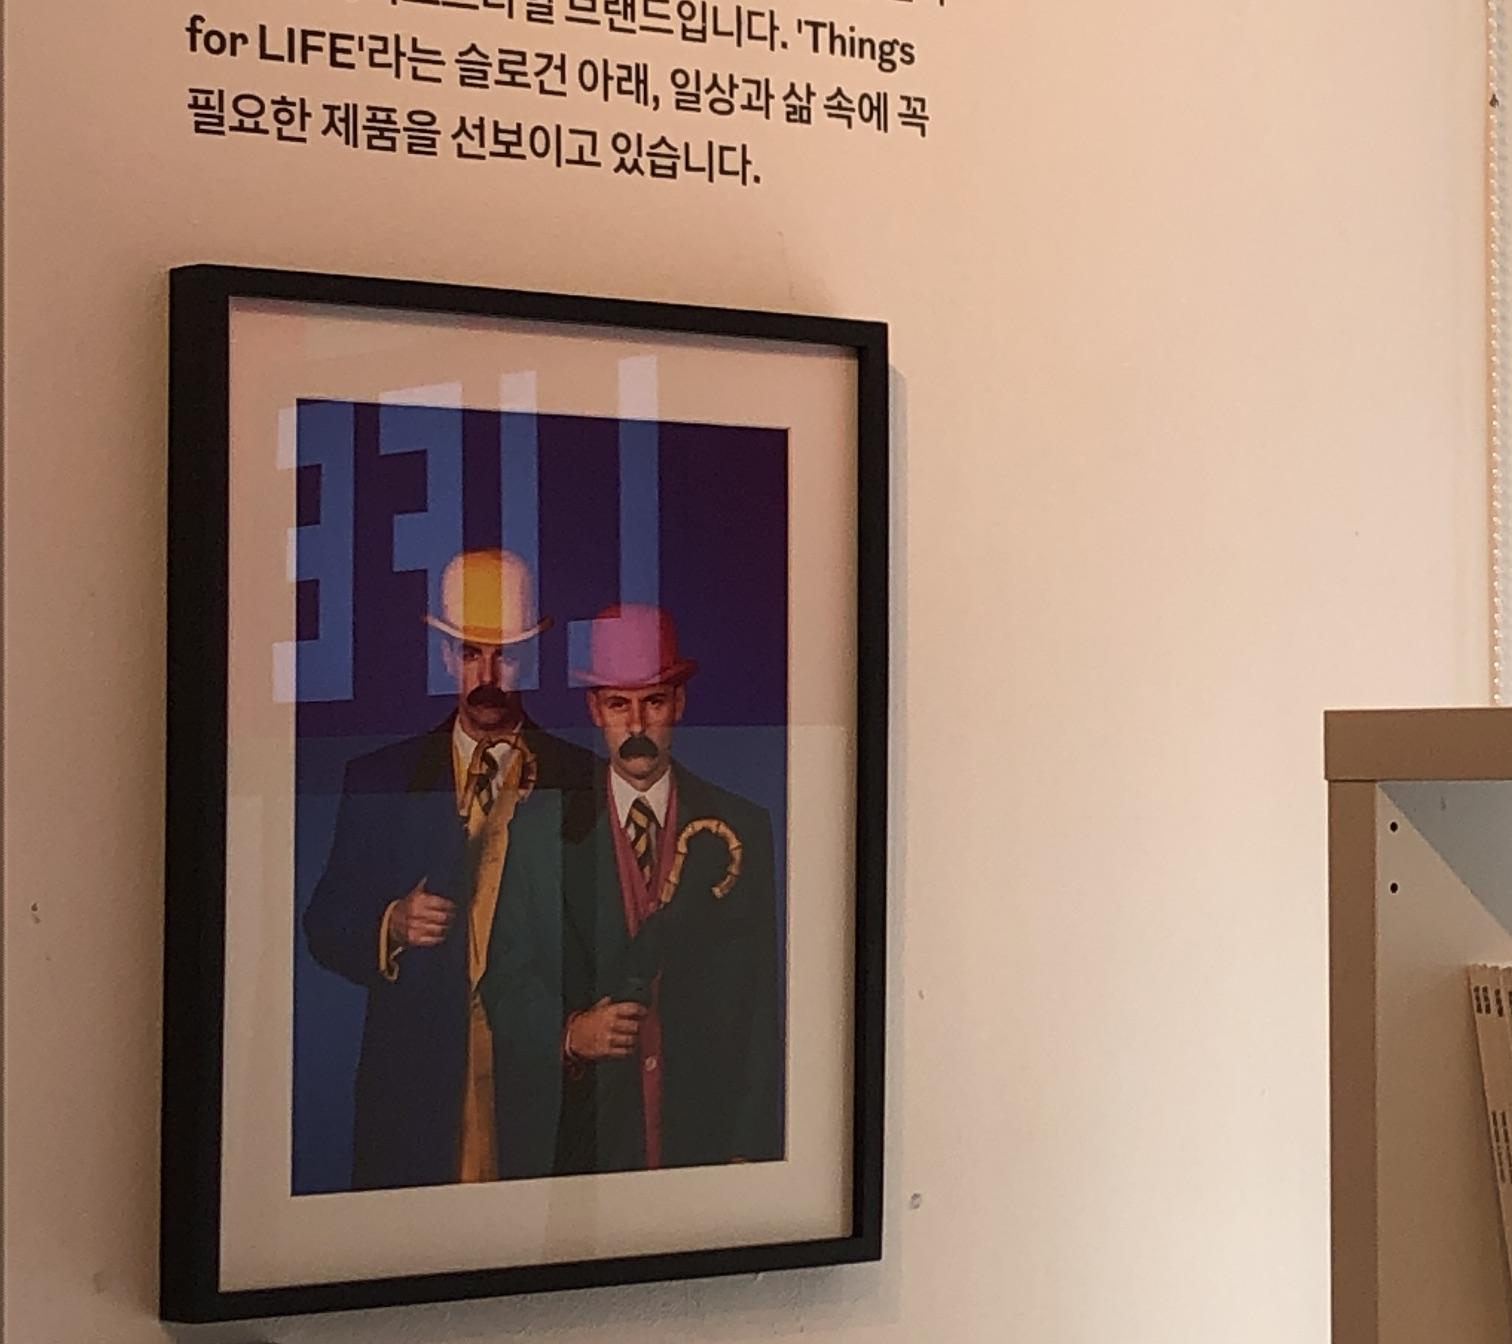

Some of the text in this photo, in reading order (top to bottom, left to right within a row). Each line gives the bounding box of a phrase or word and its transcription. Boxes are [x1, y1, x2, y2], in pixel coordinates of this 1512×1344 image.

[185, 14, 929, 138] for LIFE'라는 슬로건 아래, 일상과 삶 속에 꼭
[797, 18, 915, 74] 'Things
[187, 87, 761, 187] 필요한 제품을 선보이고 있습니다.
